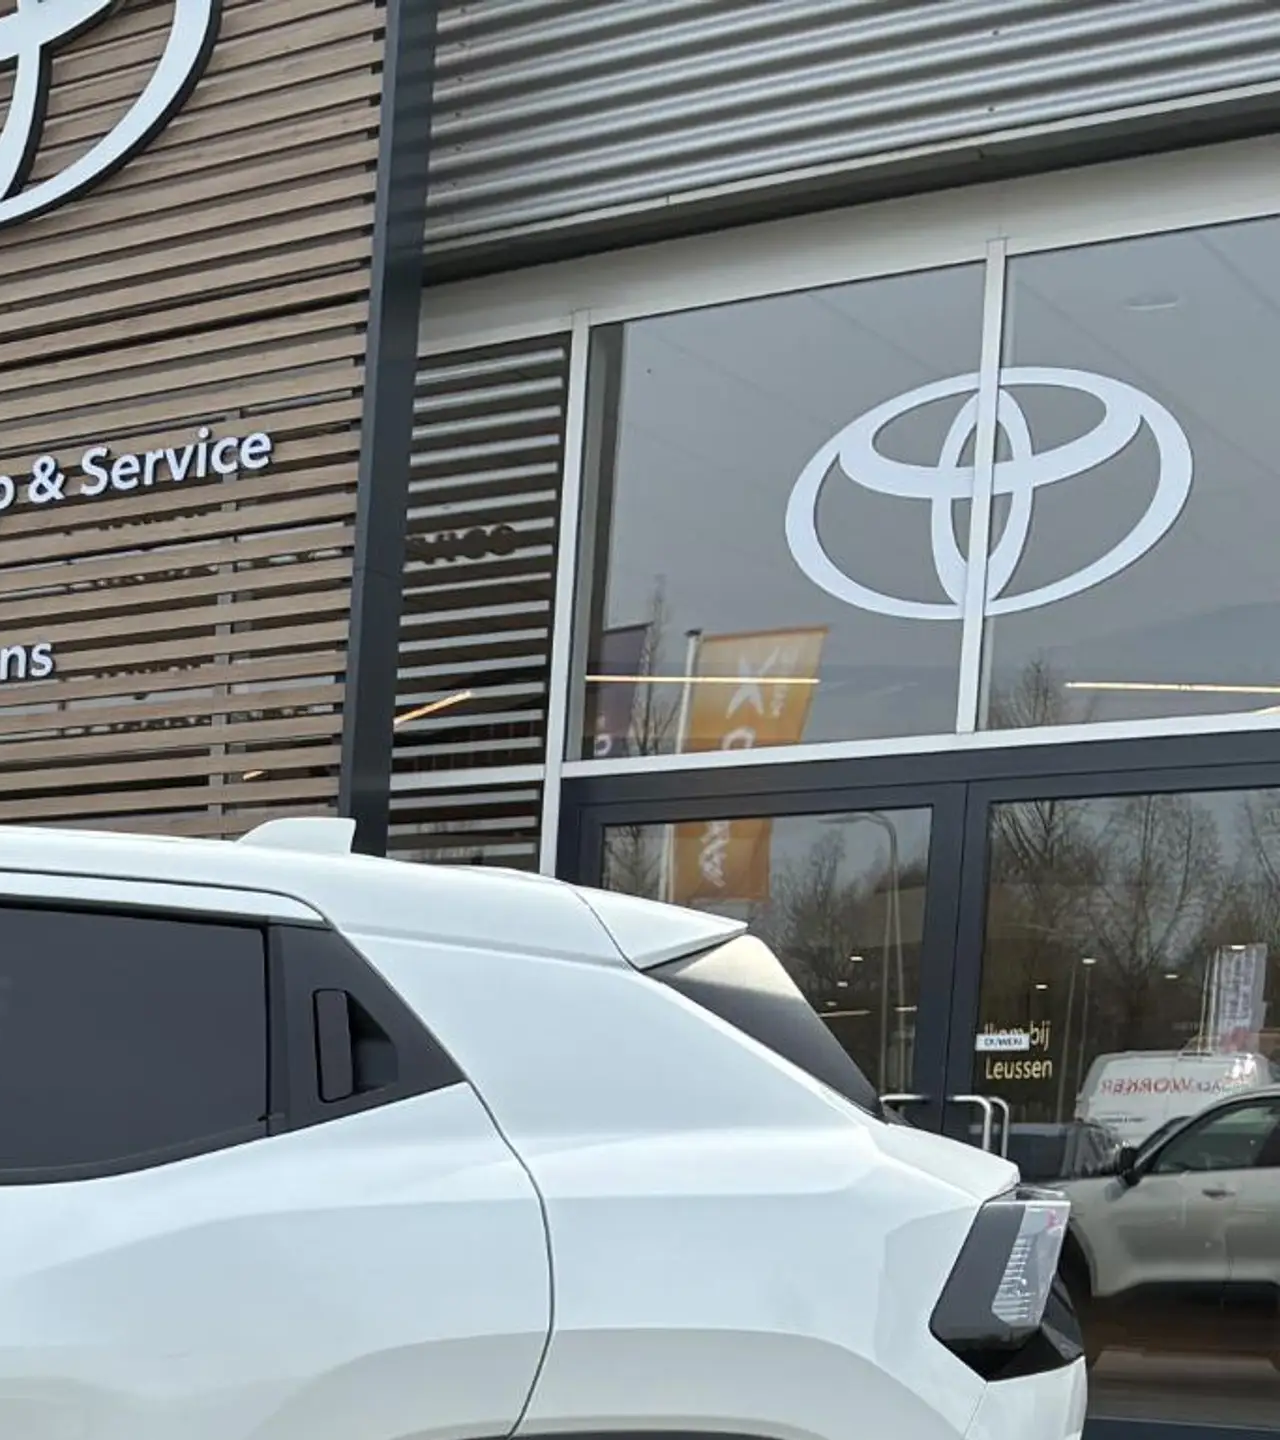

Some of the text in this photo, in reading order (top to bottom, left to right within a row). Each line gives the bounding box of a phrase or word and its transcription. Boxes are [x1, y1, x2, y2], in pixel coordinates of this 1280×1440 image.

[27, 455, 66, 503] &
[79, 426, 274, 496] Service
[1029, 1020, 1051, 1051] bij
[985, 1056, 1053, 1080] Leussen
